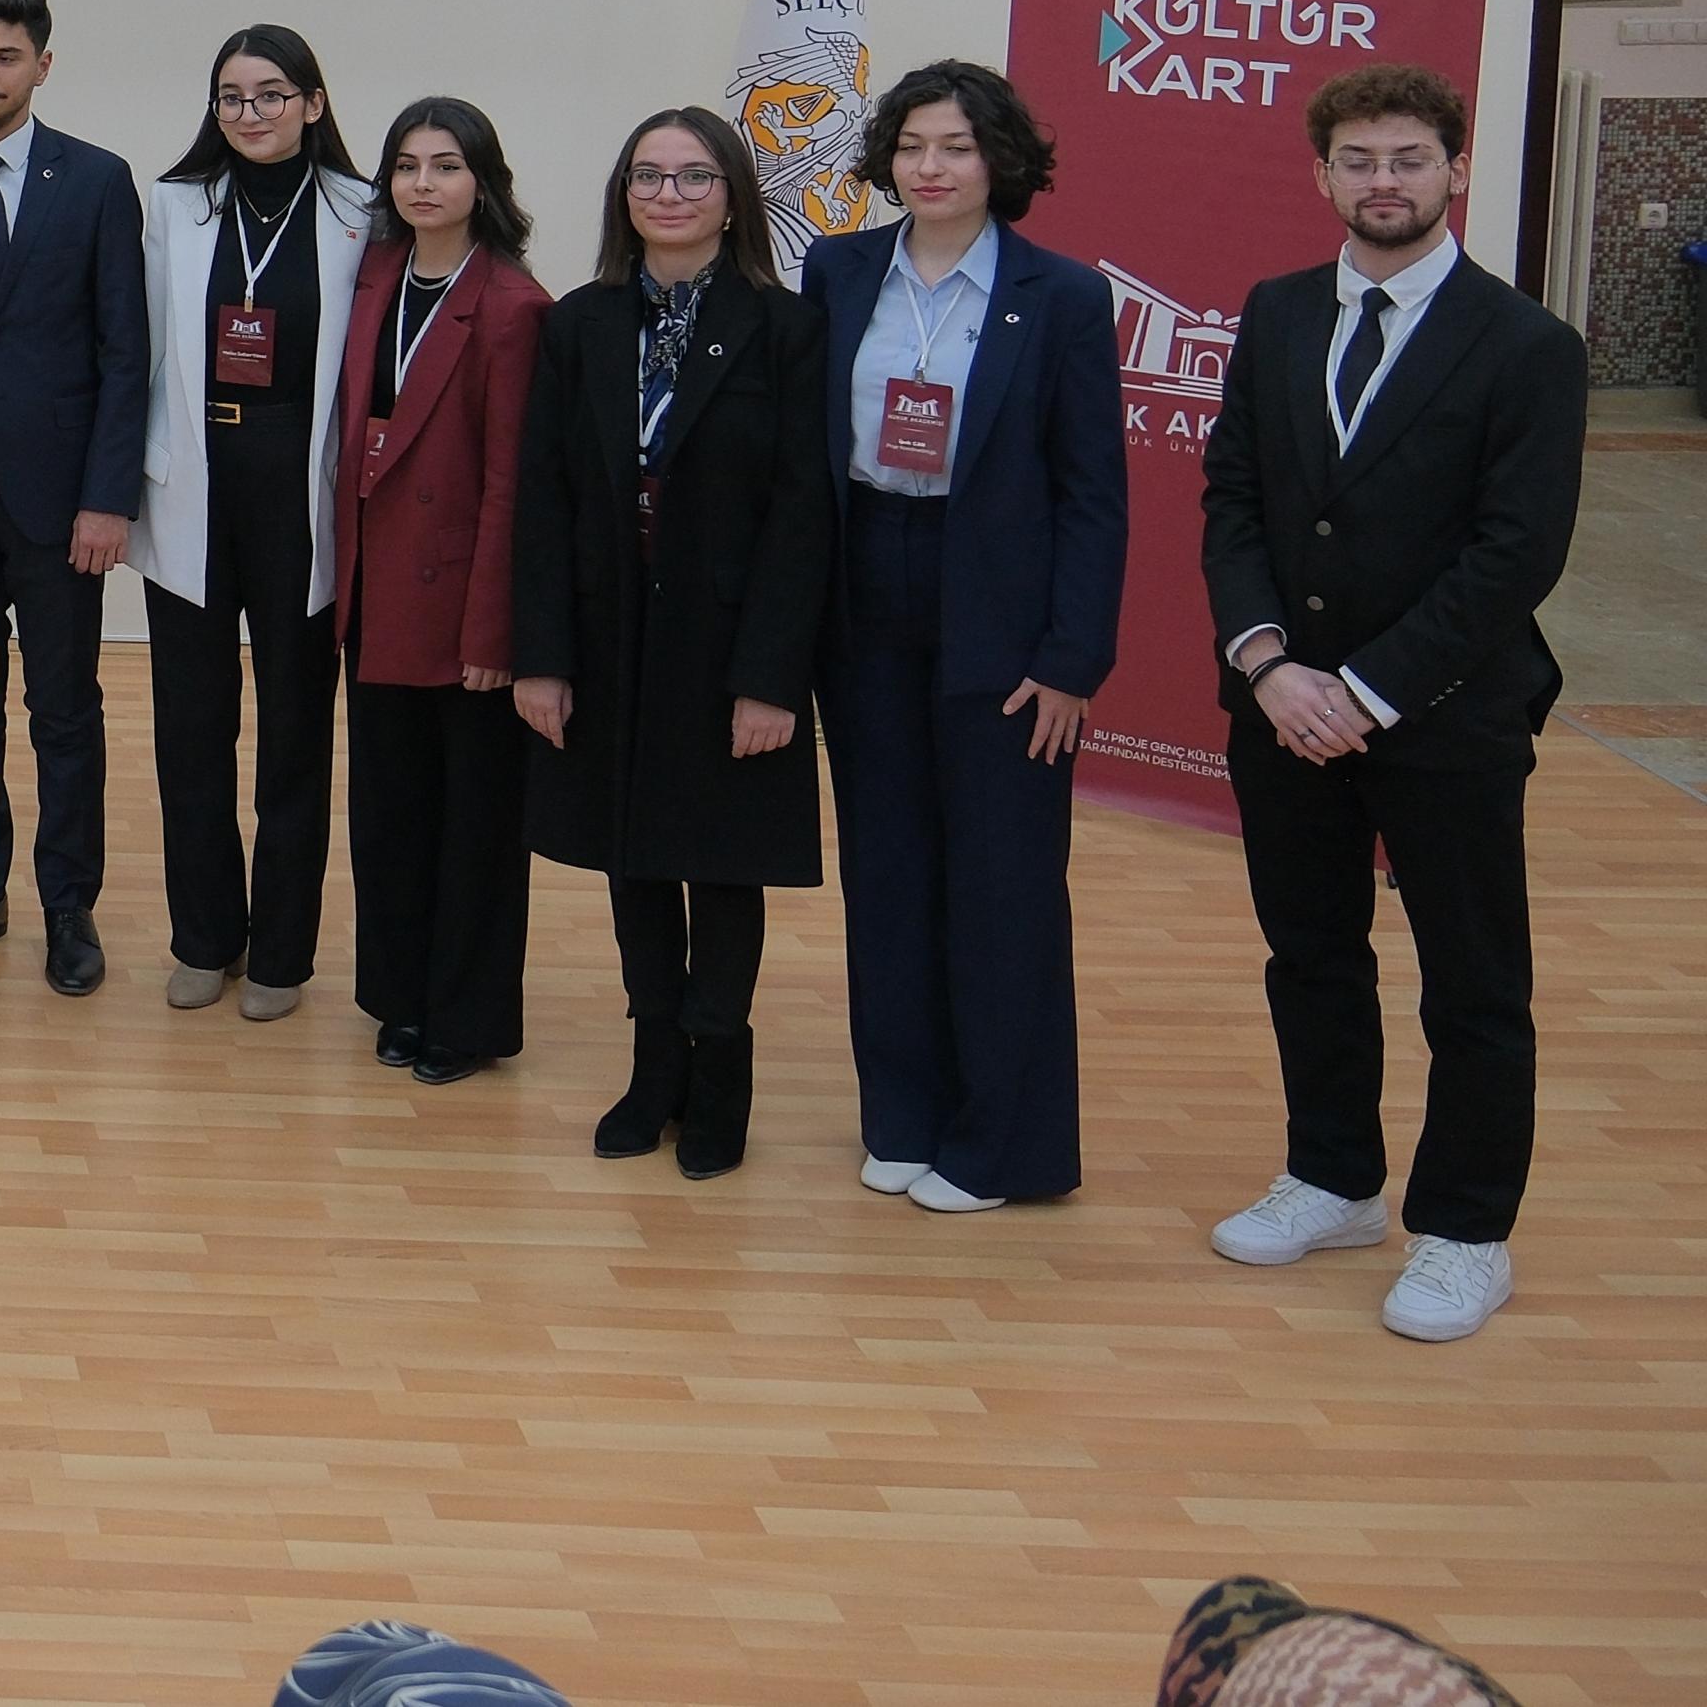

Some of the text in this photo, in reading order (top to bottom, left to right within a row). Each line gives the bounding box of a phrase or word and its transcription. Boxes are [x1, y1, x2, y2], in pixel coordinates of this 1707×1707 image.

[1108, 54, 1290, 106] KART
[1079, 739, 1150, 763] TARAFINDAN
[1093, 729, 1109, 741] BU
[1111, 733, 1148, 749] PROJE
[1150, 741, 1185, 759] GENÇ
